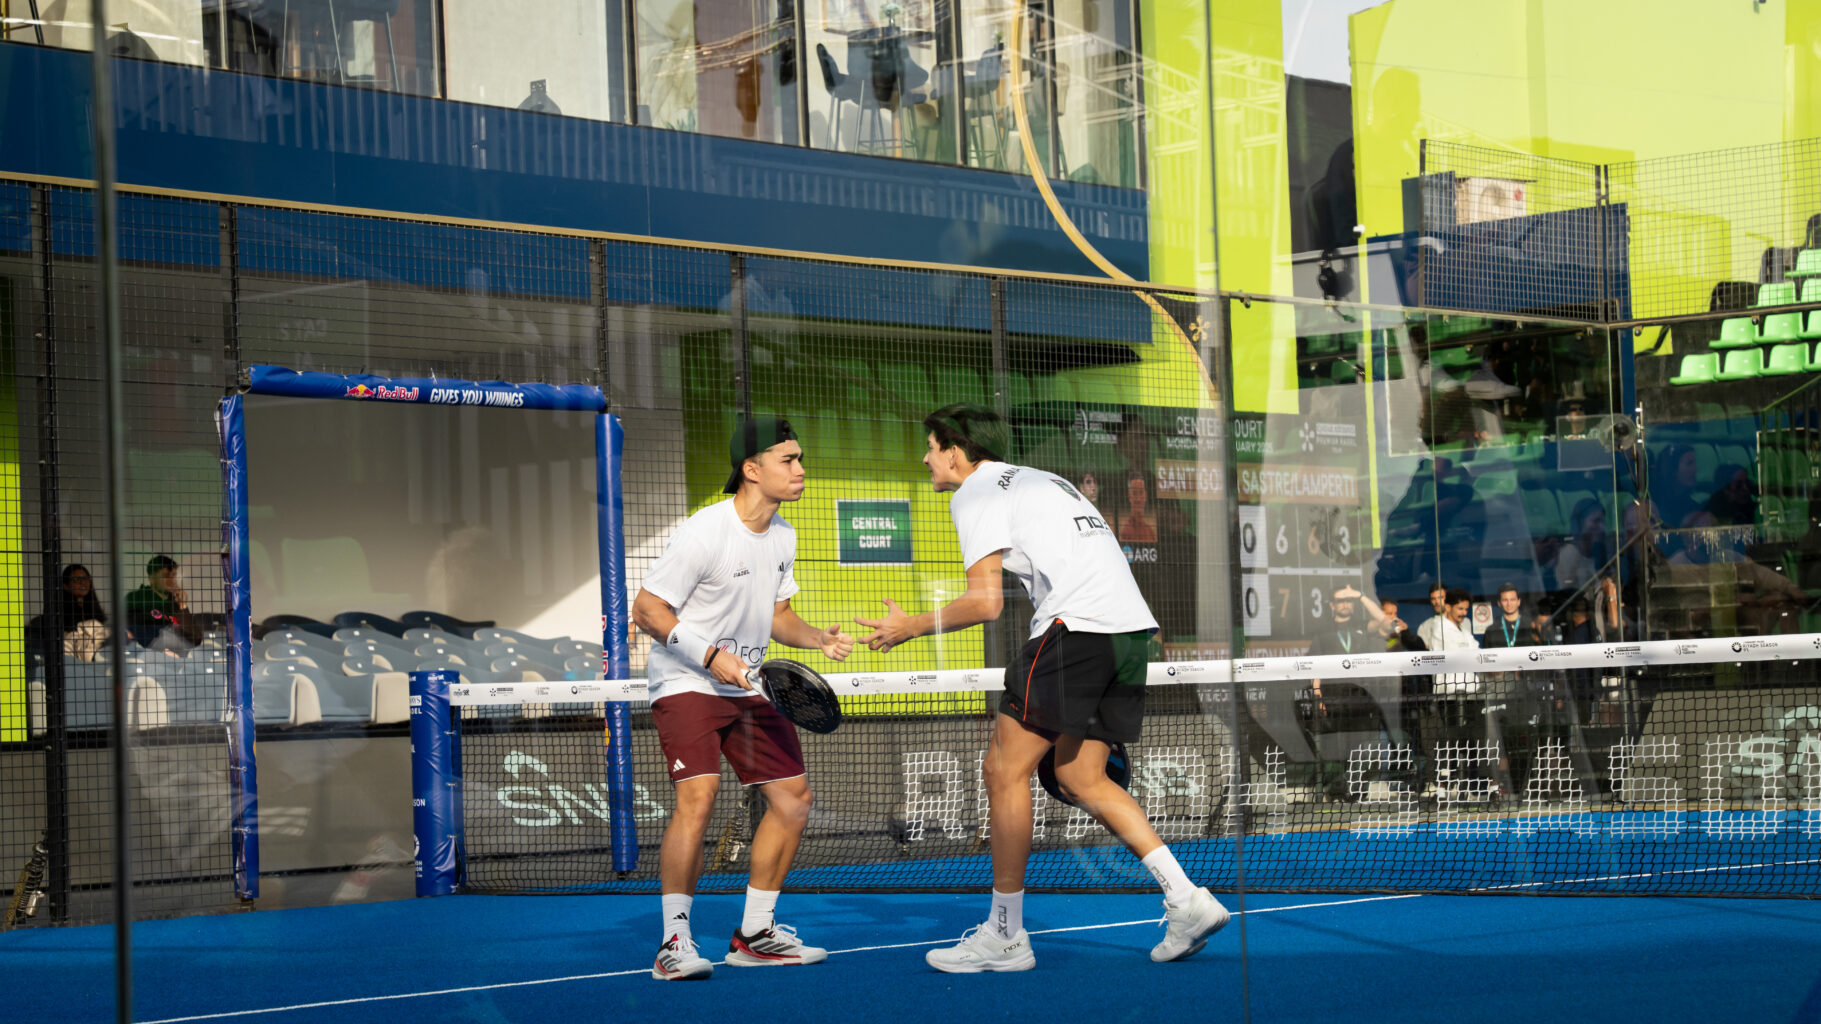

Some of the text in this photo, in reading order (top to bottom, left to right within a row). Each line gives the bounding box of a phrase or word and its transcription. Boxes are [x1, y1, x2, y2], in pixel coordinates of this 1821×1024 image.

[377, 385, 420, 401] Red Bull
[429, 388, 460, 404] GIVES
[461, 390, 483, 405] YOU
[1228, 418, 1263, 438] OURT
[852, 516, 898, 530] CENTRAL
[859, 534, 892, 548] COURT
[1242, 522, 1257, 554] 0
[1276, 524, 1351, 556] 6 6 3
[1134, 548, 1158, 562] ARG
[1245, 587, 1259, 619] 0
[1278, 588, 1323, 618] 7 3
[998, 905, 1009, 938] nox
[1004, 942, 1022, 953] nox
